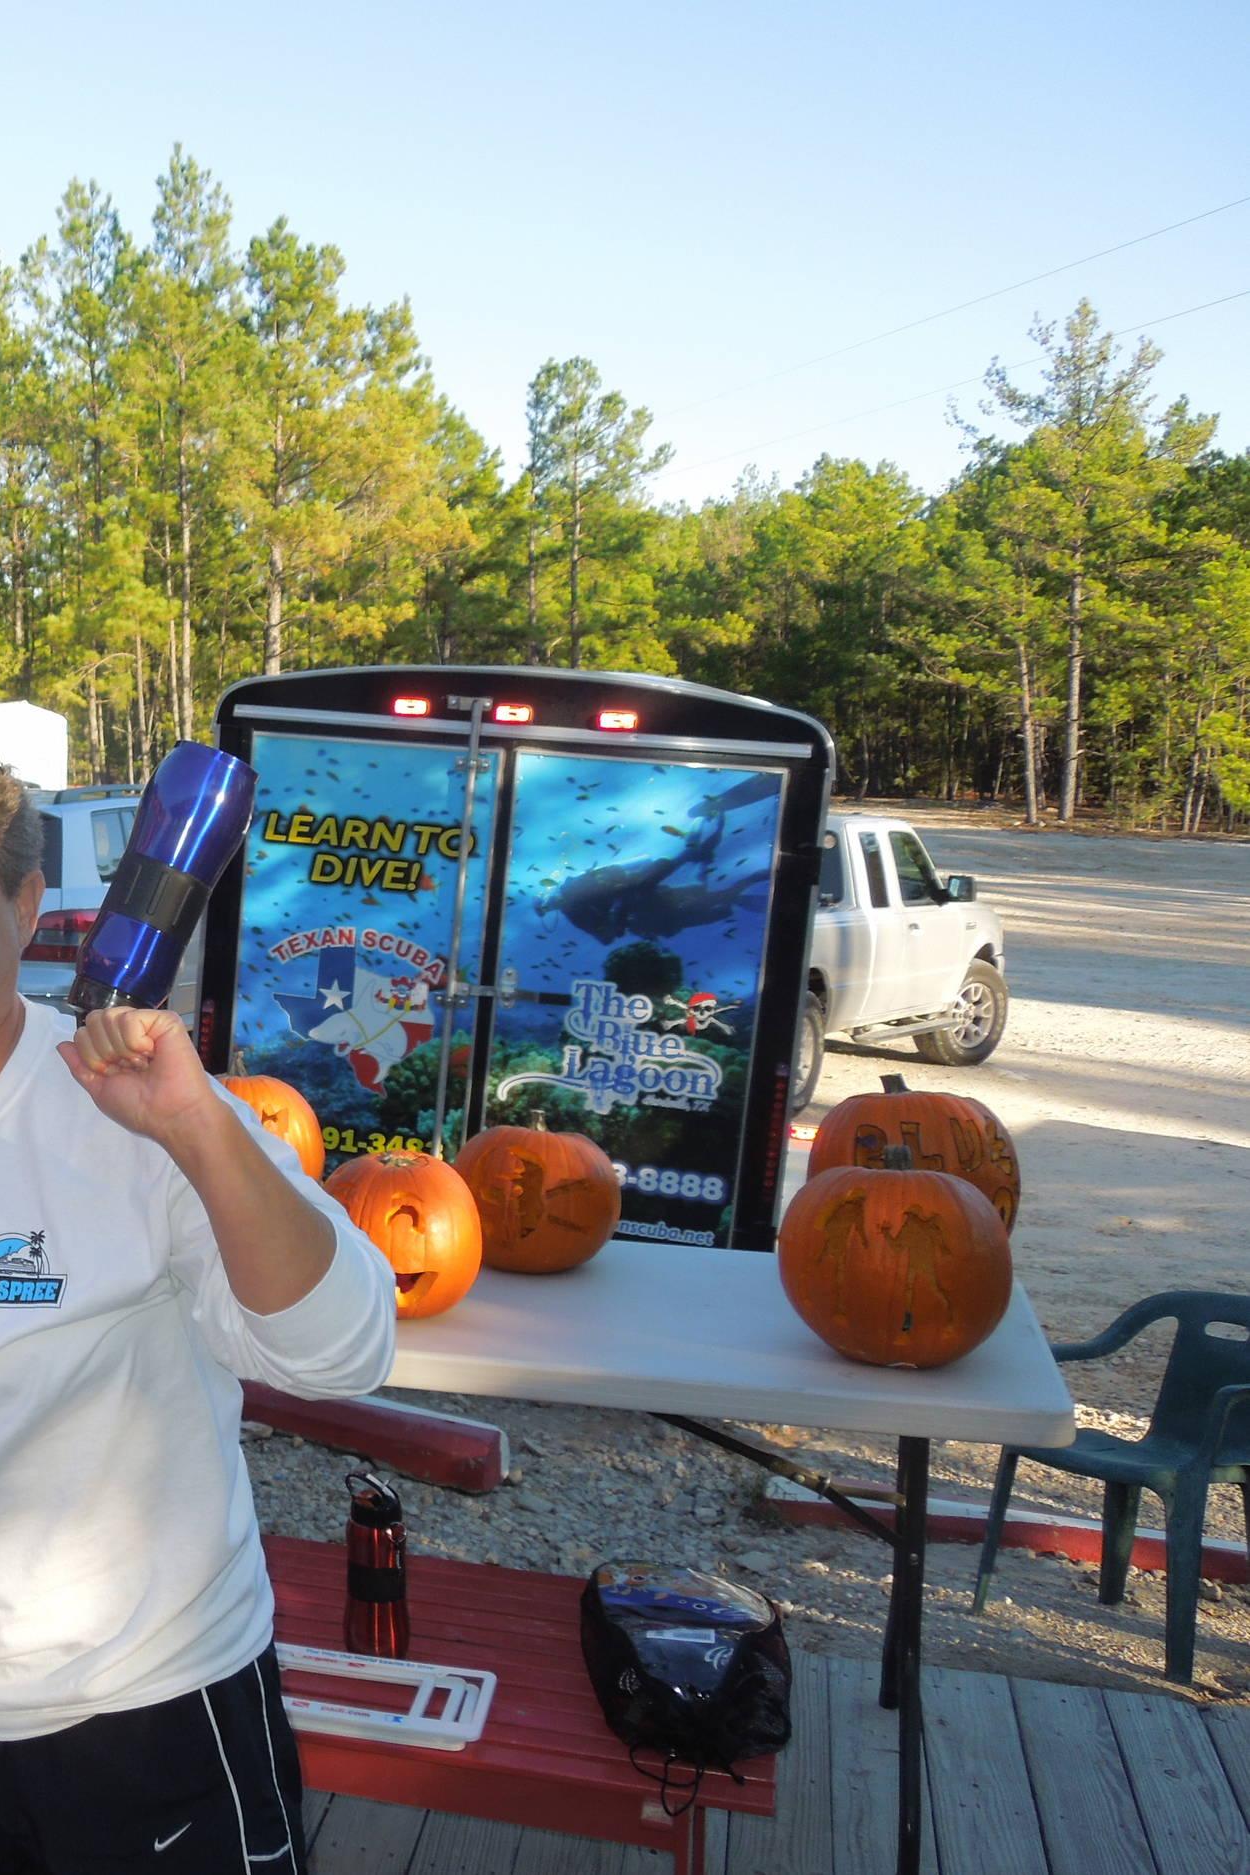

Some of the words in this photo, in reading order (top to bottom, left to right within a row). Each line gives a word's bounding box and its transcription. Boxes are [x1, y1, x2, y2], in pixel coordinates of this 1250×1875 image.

[263, 811, 407, 853] LEARN
[412, 824, 476, 859] TO
[310, 853, 422, 892] DIVE!
[270, 927, 356, 963] TEXAN
[362, 929, 445, 983] SCUBA
[568, 981, 651, 1031] The
[596, 1020, 685, 1060] Blue
[562, 1047, 716, 1097] Lagoon
